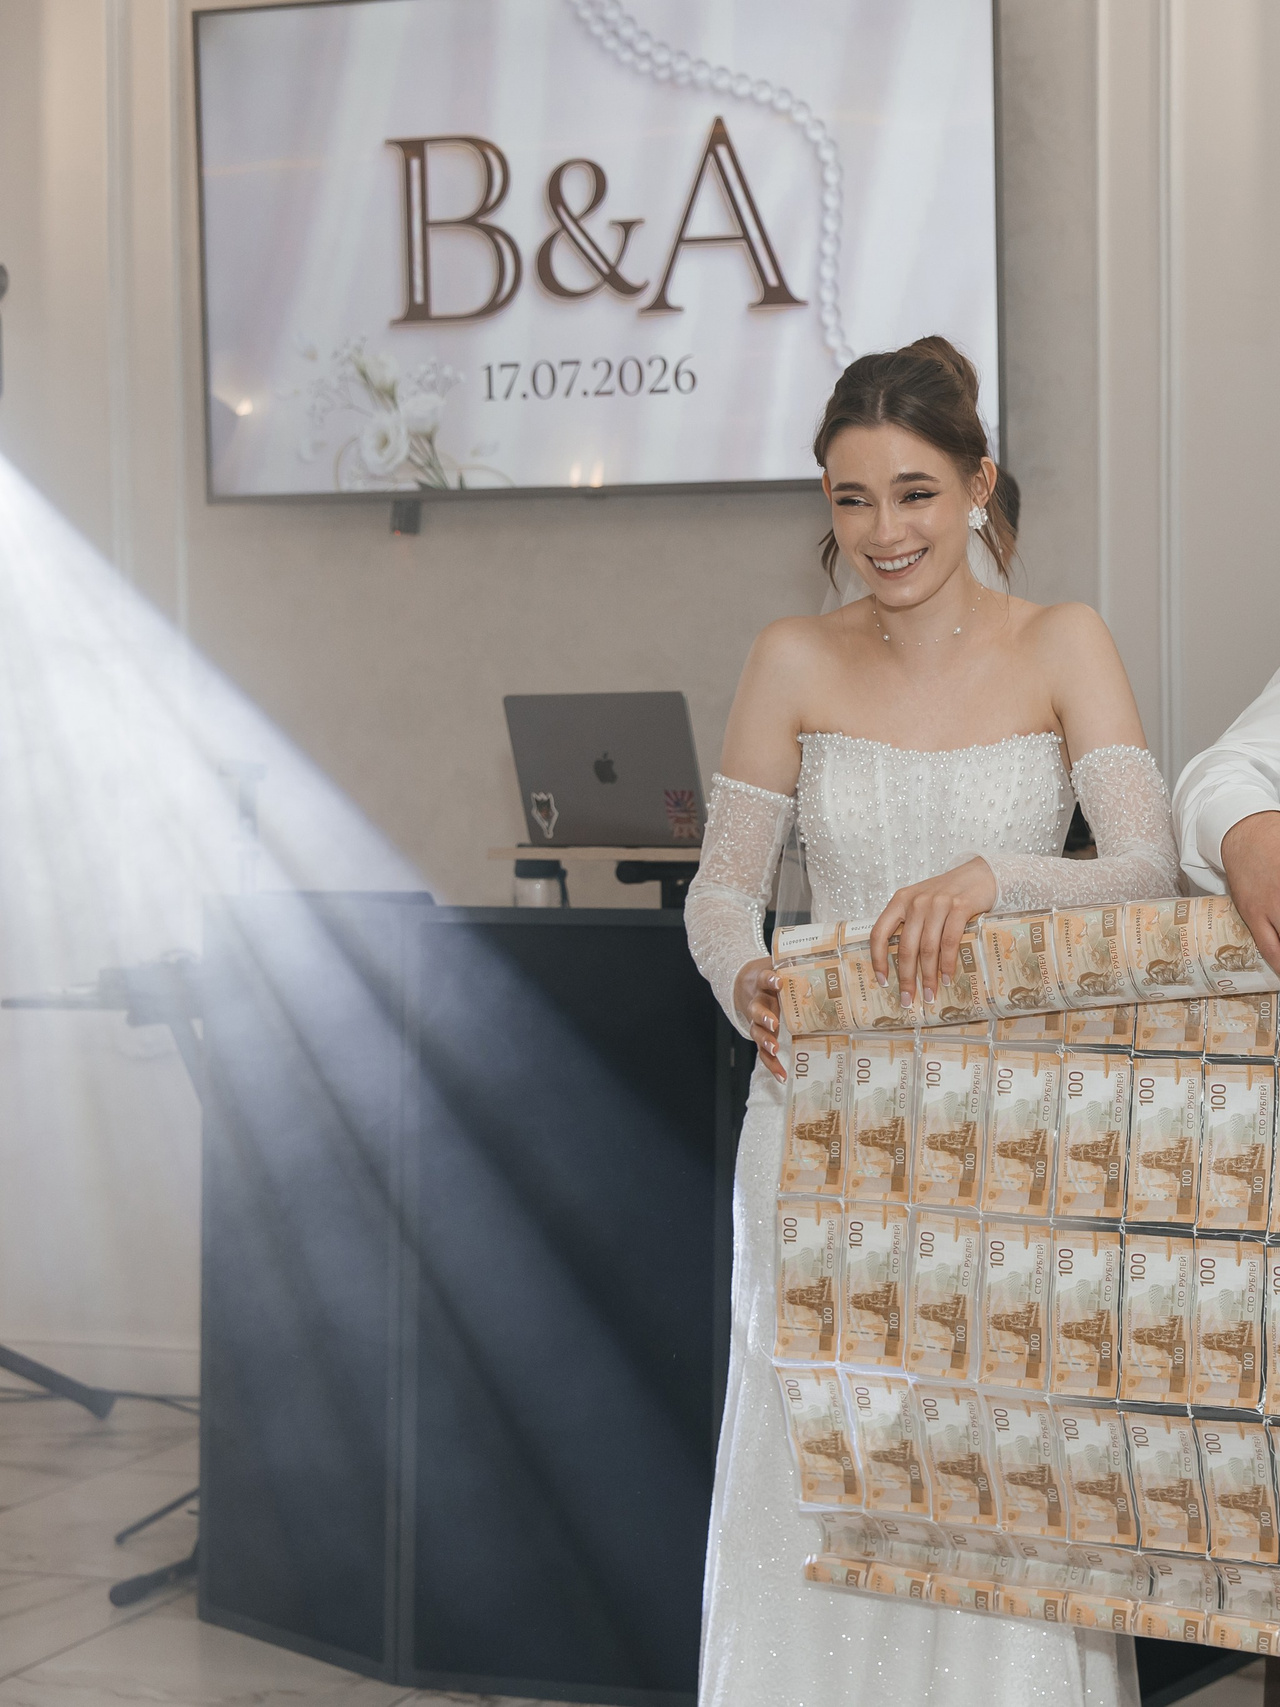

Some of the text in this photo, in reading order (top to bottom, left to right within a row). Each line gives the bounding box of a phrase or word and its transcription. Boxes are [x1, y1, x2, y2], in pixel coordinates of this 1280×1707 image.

[385, 116, 808, 327] B&A
[482, 354, 697, 402] 17.07.2026
[1177, 903, 1187, 918] 100
[1104, 913, 1114, 929] 100
[1033, 926, 1042, 944] 100
[961, 948, 973, 965] 100
[827, 973, 838, 990] 100
[1260, 1002, 1270, 1020] 100
[796, 1052, 809, 1079] 100
[857, 1058, 871, 1085] 100
[927, 1062, 941, 1088] 100
[973, 1064, 981, 1095] РУБЛЕЙ
[997, 1069, 1013, 1096] 100
[1044, 1072, 1053, 1103] РУБЛЕЙ
[1068, 1072, 1083, 1099] 100
[1139, 1078, 1154, 1106] 100
[1211, 1084, 1226, 1112] 100
[831, 1142, 840, 1158] 100
[896, 1148, 904, 1165] 100
[965, 1153, 974, 1171] 100
[1036, 1161, 1045, 1178] 100
[1109, 1163, 1119, 1180] 100
[1182, 1169, 1192, 1187] 100
[1253, 1176, 1263, 1194] 100
[783, 1218, 797, 1245] 100
[849, 1222, 863, 1249] 100
[920, 1232, 934, 1259] 100
[964, 1238, 972, 1268] РУБЛЕЙ
[990, 1241, 1004, 1268] 100
[1058, 1249, 1073, 1276] 100
[1105, 1251, 1113, 1283] РУБЛЕЙ
[1131, 1253, 1146, 1282] 100
[1200, 1258, 1215, 1286] 100
[824, 1308, 832, 1324] 100
[890, 1313, 898, 1330] 100
[956, 1325, 965, 1343] 100
[1031, 1334, 1040, 1351] 100
[1101, 1342, 1111, 1359] 100
[1174, 1348, 1184, 1365] 100
[1244, 1353, 1253, 1371] 100
[786, 1380, 800, 1403] 100
[855, 1387, 871, 1411] 100
[923, 1399, 939, 1422] 100
[994, 1409, 1009, 1432] 100
[1063, 1418, 1079, 1441] 100
[1132, 1427, 1149, 1448] 100
[1204, 1434, 1222, 1455] 100
[842, 1457, 852, 1470] 100
[910, 1465, 919, 1479] 100
[978, 1478, 988, 1492] 100
[1048, 1489, 1057, 1502] 100
[1117, 1498, 1126, 1512] 100
[1188, 1504, 1198, 1518] 100
[1261, 1512, 1270, 1527] 100
[1224, 1567, 1242, 1586] 100
